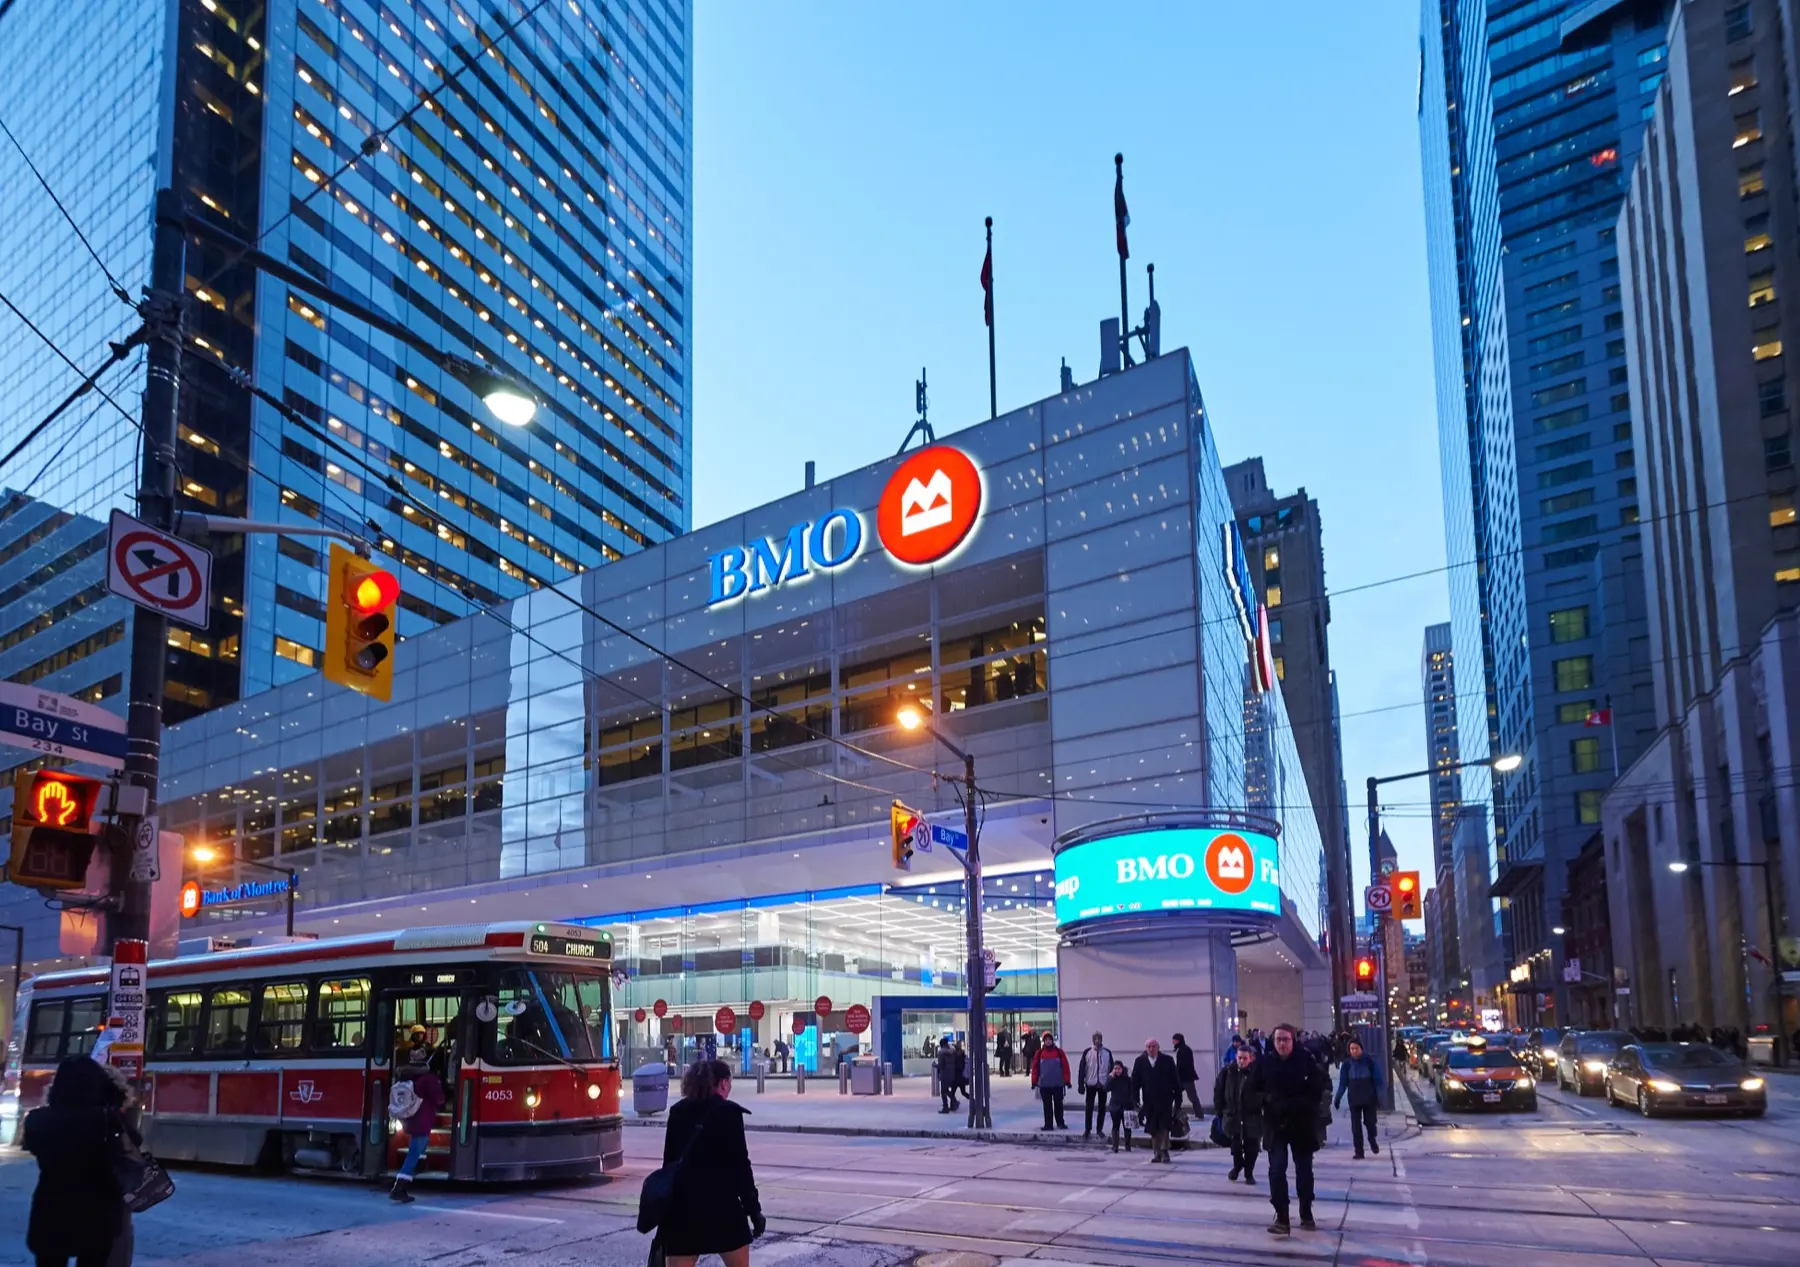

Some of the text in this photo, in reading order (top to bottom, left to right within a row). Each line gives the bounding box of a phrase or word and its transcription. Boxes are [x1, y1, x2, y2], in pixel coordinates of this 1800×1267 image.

[707, 508, 861, 605] BMO
[15, 709, 59, 738] Bay
[71, 726, 89, 743] St
[32, 739, 64, 754] 234
[940, 828, 955, 846] Bay
[1116, 853, 1195, 883] BMO
[203, 886, 230, 905] Bank
[230, 883, 243, 899] of
[566, 929, 582, 938] 4053
[533, 939, 595, 957] 504 CHURCH
[485, 1089, 513, 1101] 4053
